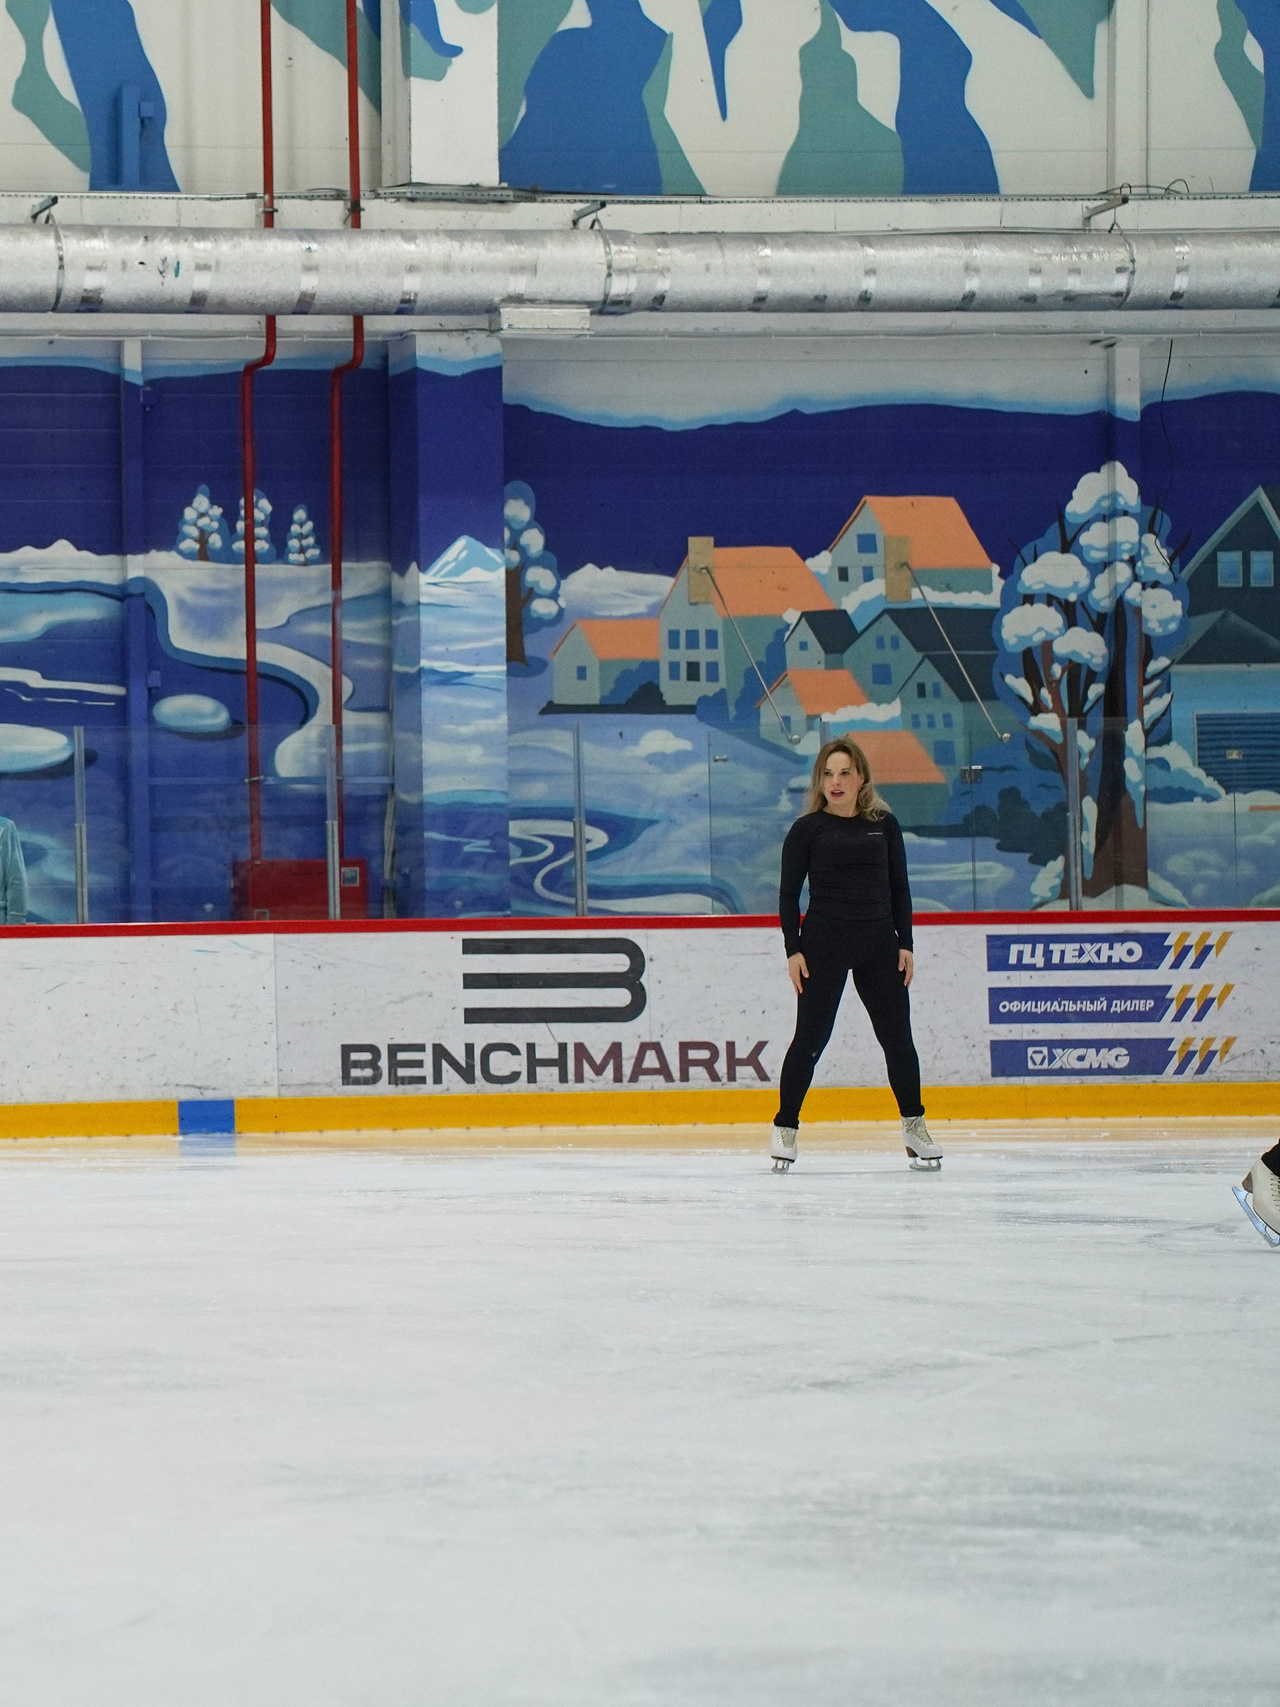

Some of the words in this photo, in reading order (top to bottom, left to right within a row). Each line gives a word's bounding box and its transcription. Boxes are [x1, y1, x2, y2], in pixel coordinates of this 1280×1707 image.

[1008, 943, 1045, 968] ГЦ
[1049, 941, 1143, 964] ТЕХНО
[998, 997, 1107, 1014] ОФИЦИАЛЬНЫЙ
[1110, 999, 1155, 1013] ДИЛЕР
[340, 1040, 771, 1086] BENCHMARK
[1048, 1047, 1130, 1069] XCMG
